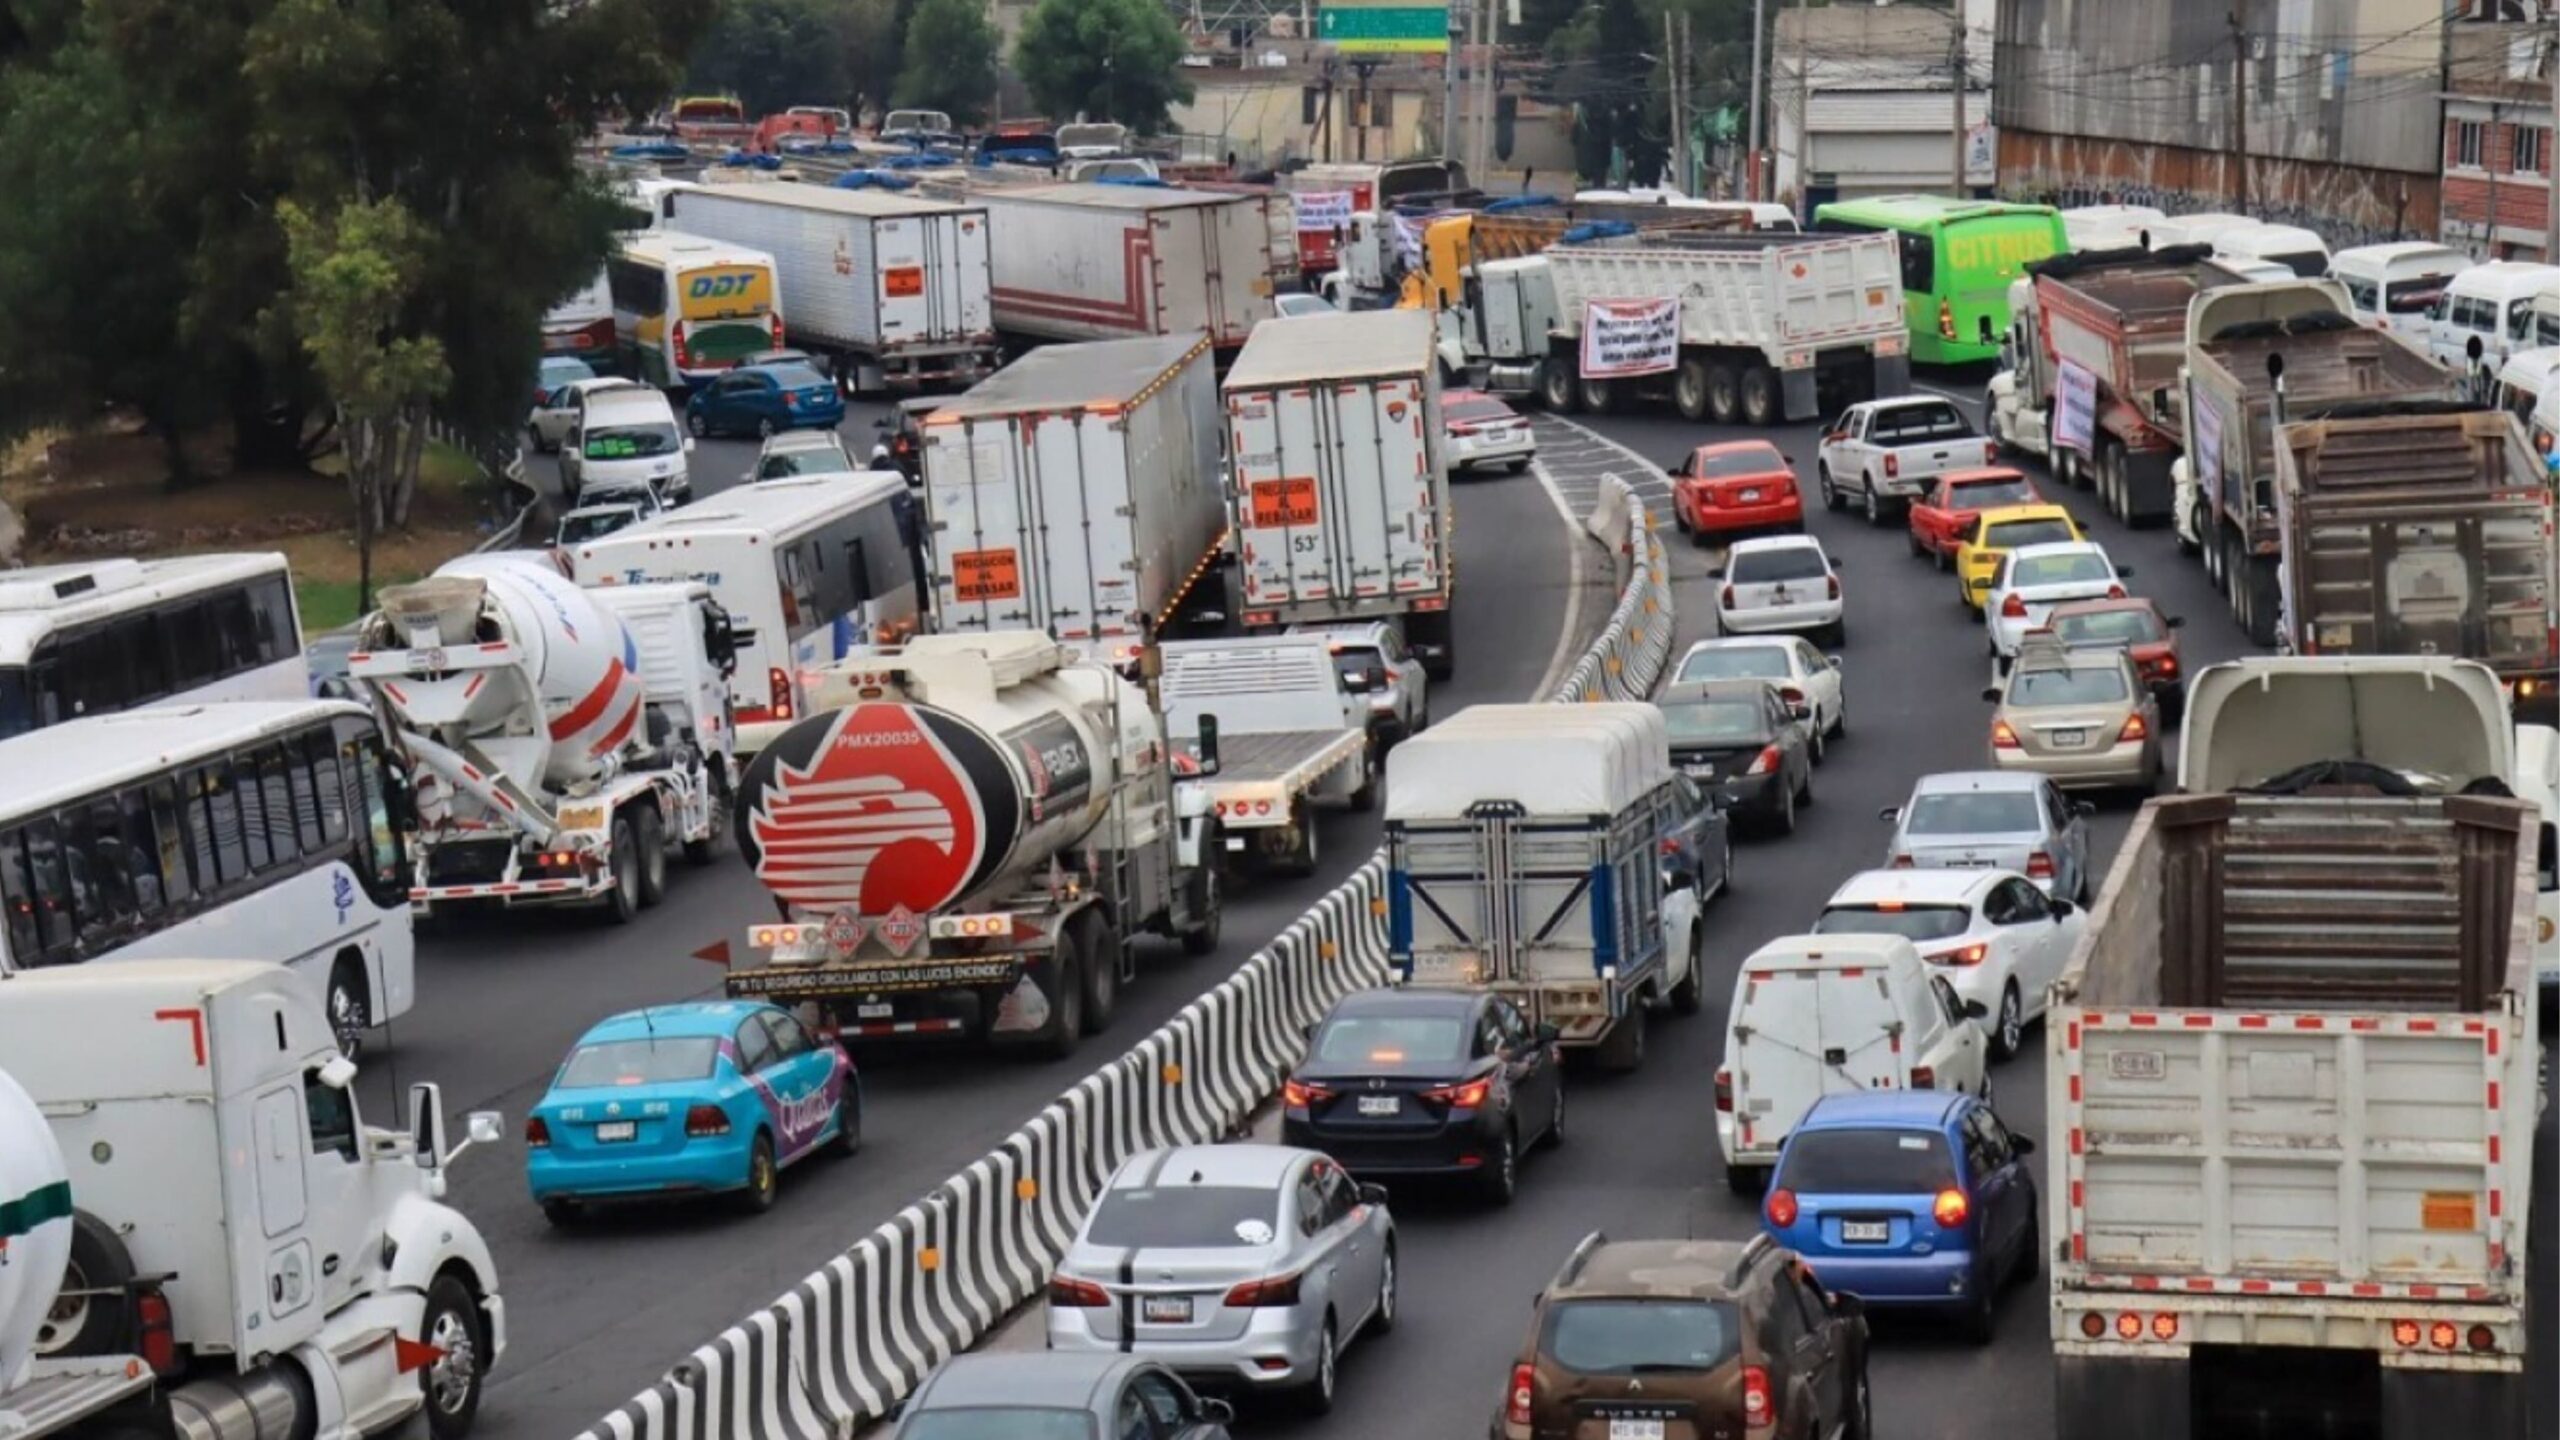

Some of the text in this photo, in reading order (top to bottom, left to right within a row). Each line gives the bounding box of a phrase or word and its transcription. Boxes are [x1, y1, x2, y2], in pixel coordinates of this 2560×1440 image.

[1949, 230, 2052, 269] CITRUS
[690, 274, 755, 297] DDT
[1257, 508, 1313, 523] REBASAR
[958, 582, 1014, 597] REBASAR
[837, 730, 919, 749] PMX20035
[764, 972, 816, 990] SEGURIDAD
[818, 967, 879, 986] CIRCULAMOS
[881, 968, 899, 982] CON
[901, 967, 920, 981] LAS
[922, 964, 952, 981] LUCES
